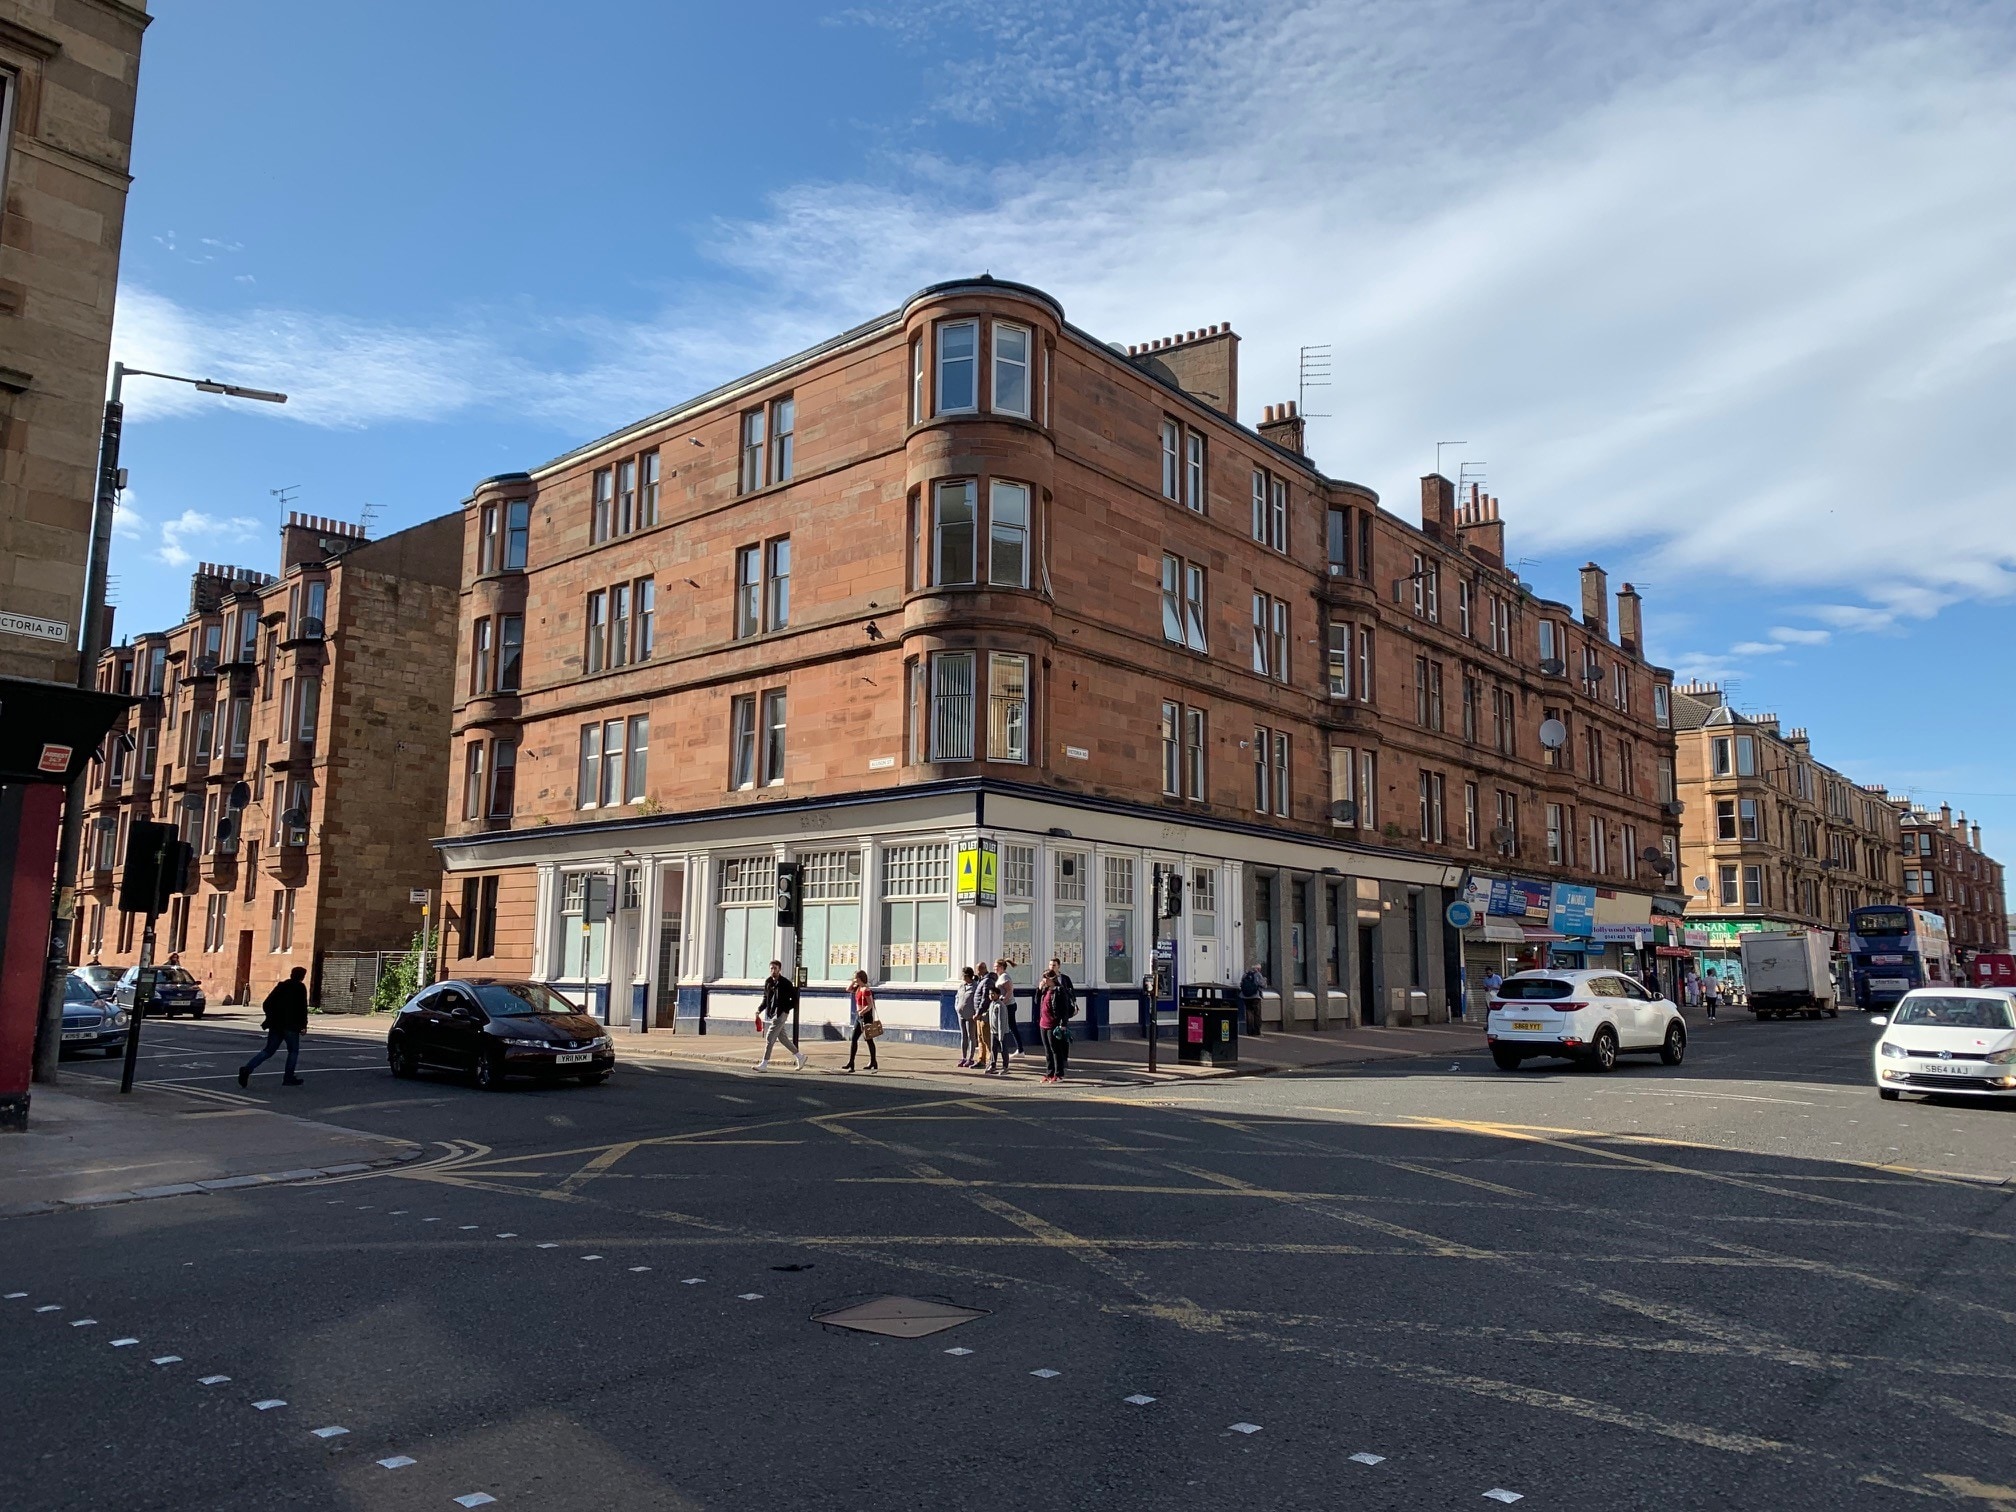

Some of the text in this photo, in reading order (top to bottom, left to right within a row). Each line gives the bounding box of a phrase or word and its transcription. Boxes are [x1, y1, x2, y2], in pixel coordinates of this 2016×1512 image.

[0, 617, 63, 636] CTORIA RD
[959, 840, 977, 852] TO LET
[982, 840, 989, 851] TO
[1695, 922, 1726, 932] KHAN
[1925, 1064, 1969, 1075] SB64 AAJ
